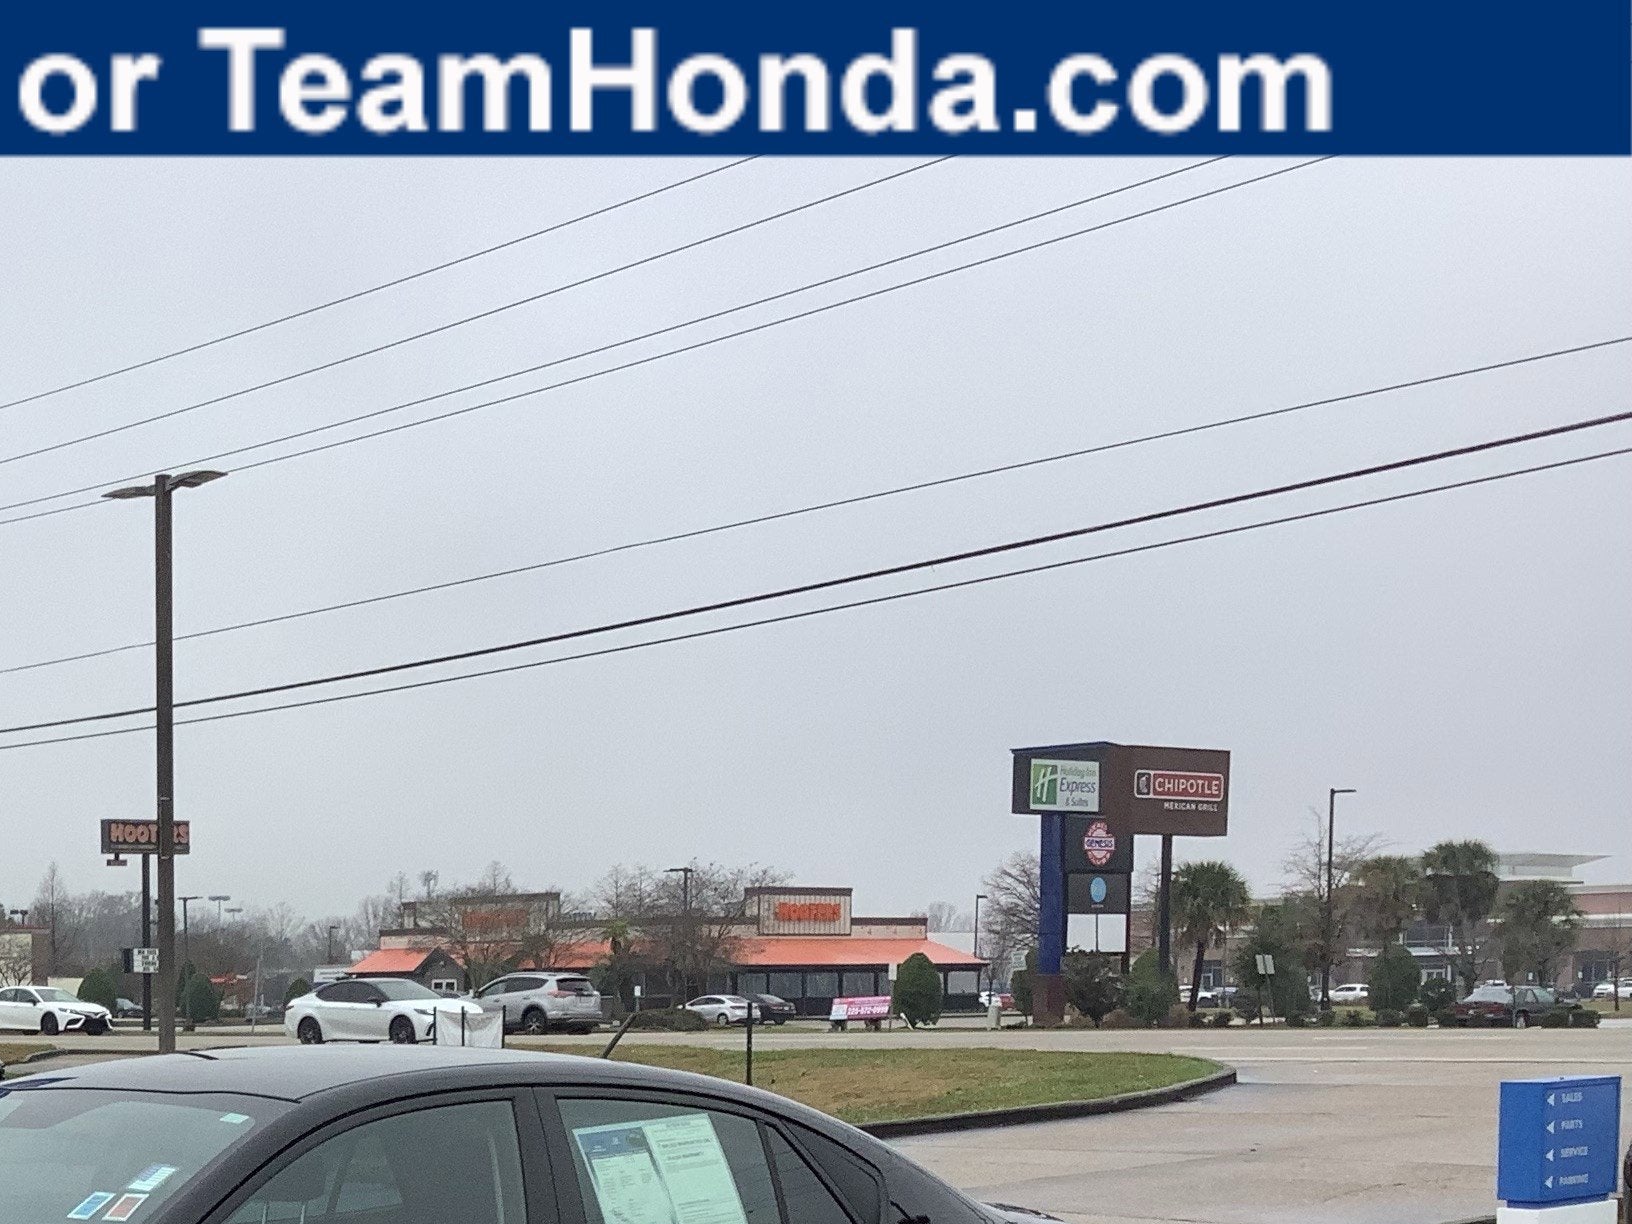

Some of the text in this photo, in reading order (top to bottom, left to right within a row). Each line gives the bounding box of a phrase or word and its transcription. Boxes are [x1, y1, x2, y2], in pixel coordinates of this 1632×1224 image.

[1059, 777, 1097, 796] Express
[1154, 777, 1221, 795] CHIPOTLE
[1163, 801, 1196, 811] MEXICAN
[110, 822, 189, 844] HOOTRS
